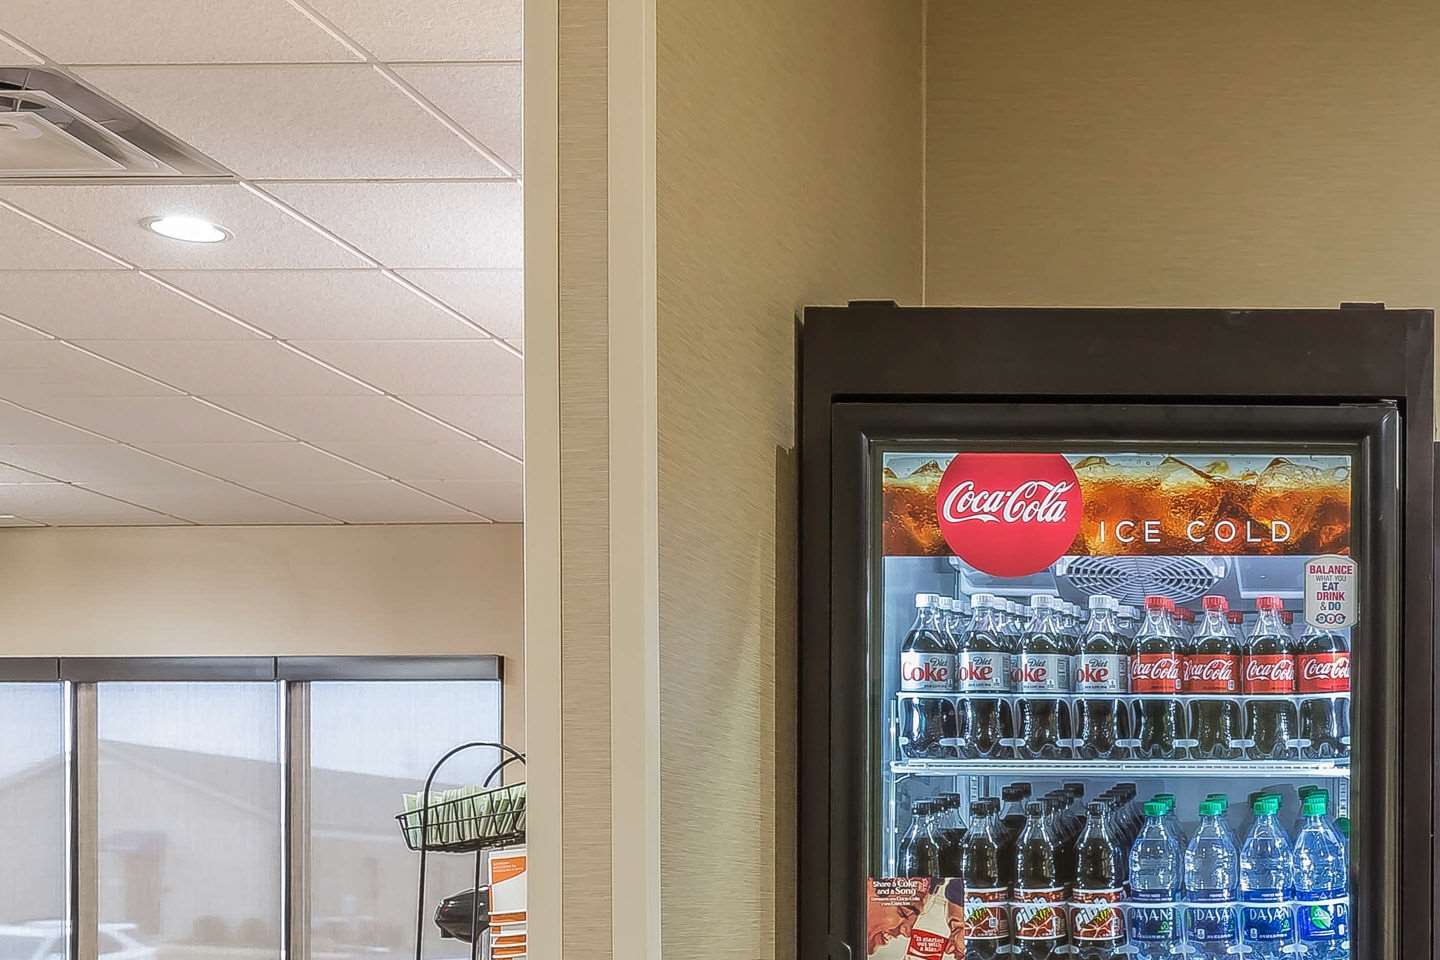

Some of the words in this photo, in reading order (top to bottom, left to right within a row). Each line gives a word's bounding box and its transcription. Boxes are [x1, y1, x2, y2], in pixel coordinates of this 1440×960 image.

[942, 480, 1074, 524] Coca-Cola
[1100, 520, 1162, 543] ICE
[1187, 520, 1292, 543] COLD
[1309, 565, 1353, 574] BALANCE
[1322, 582, 1339, 591] EAT
[1316, 592, 1345, 600] DRINK
[1320, 602, 1327, 610] &
[1328, 602, 1341, 610] DO
[902, 662, 948, 681] Coke
[1076, 663, 1109, 682] oke
[1303, 657, 1349, 680] Coca-Col
[897, 879, 918, 888] Coke
[895, 887, 917, 897] Song
[1131, 907, 1171, 921] DASAN
